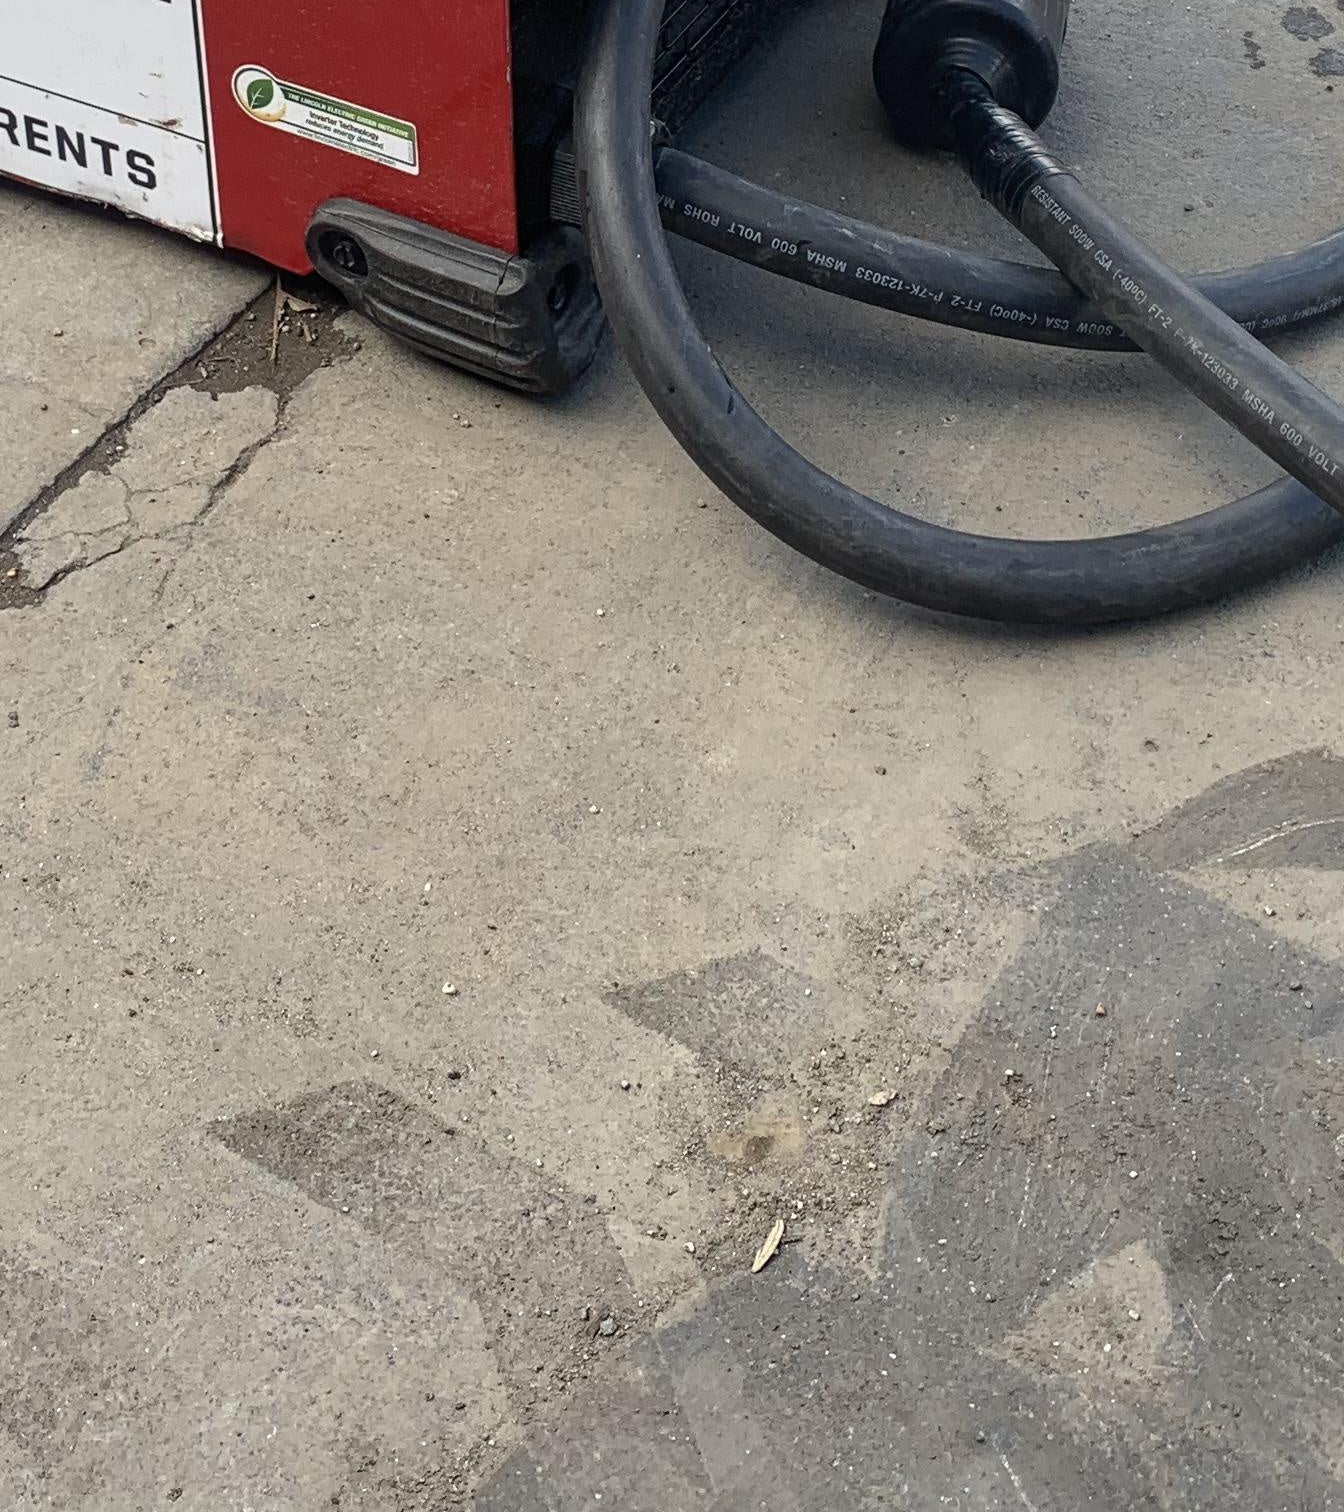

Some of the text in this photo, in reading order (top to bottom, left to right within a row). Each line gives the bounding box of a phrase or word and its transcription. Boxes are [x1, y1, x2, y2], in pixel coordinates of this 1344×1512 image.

[300, 95, 327, 111] LINCOLN
[305, 118, 385, 150] reduces energy demand
[309, 110, 380, 141] Inverter Technology
[684, 203, 720, 228] ROHS
[727, 221, 762, 243] VOLT
[771, 238, 798, 256] 600
[806, 248, 848, 273] MSHA
[855, 266, 944, 304] P-7K-123033
[950, 294, 982, 312] FT-2
[1031, 184, 1071, 226] RESISTANT
[1094, 248, 1115, 272] CSA
[1147, 301, 1174, 329] FT-2
[1241, 388, 1275, 426] MSHA
[1278, 421, 1304, 450] 600
[1307, 444, 1341, 477] VOLT
[1045, 316, 1070, 331] CSA
